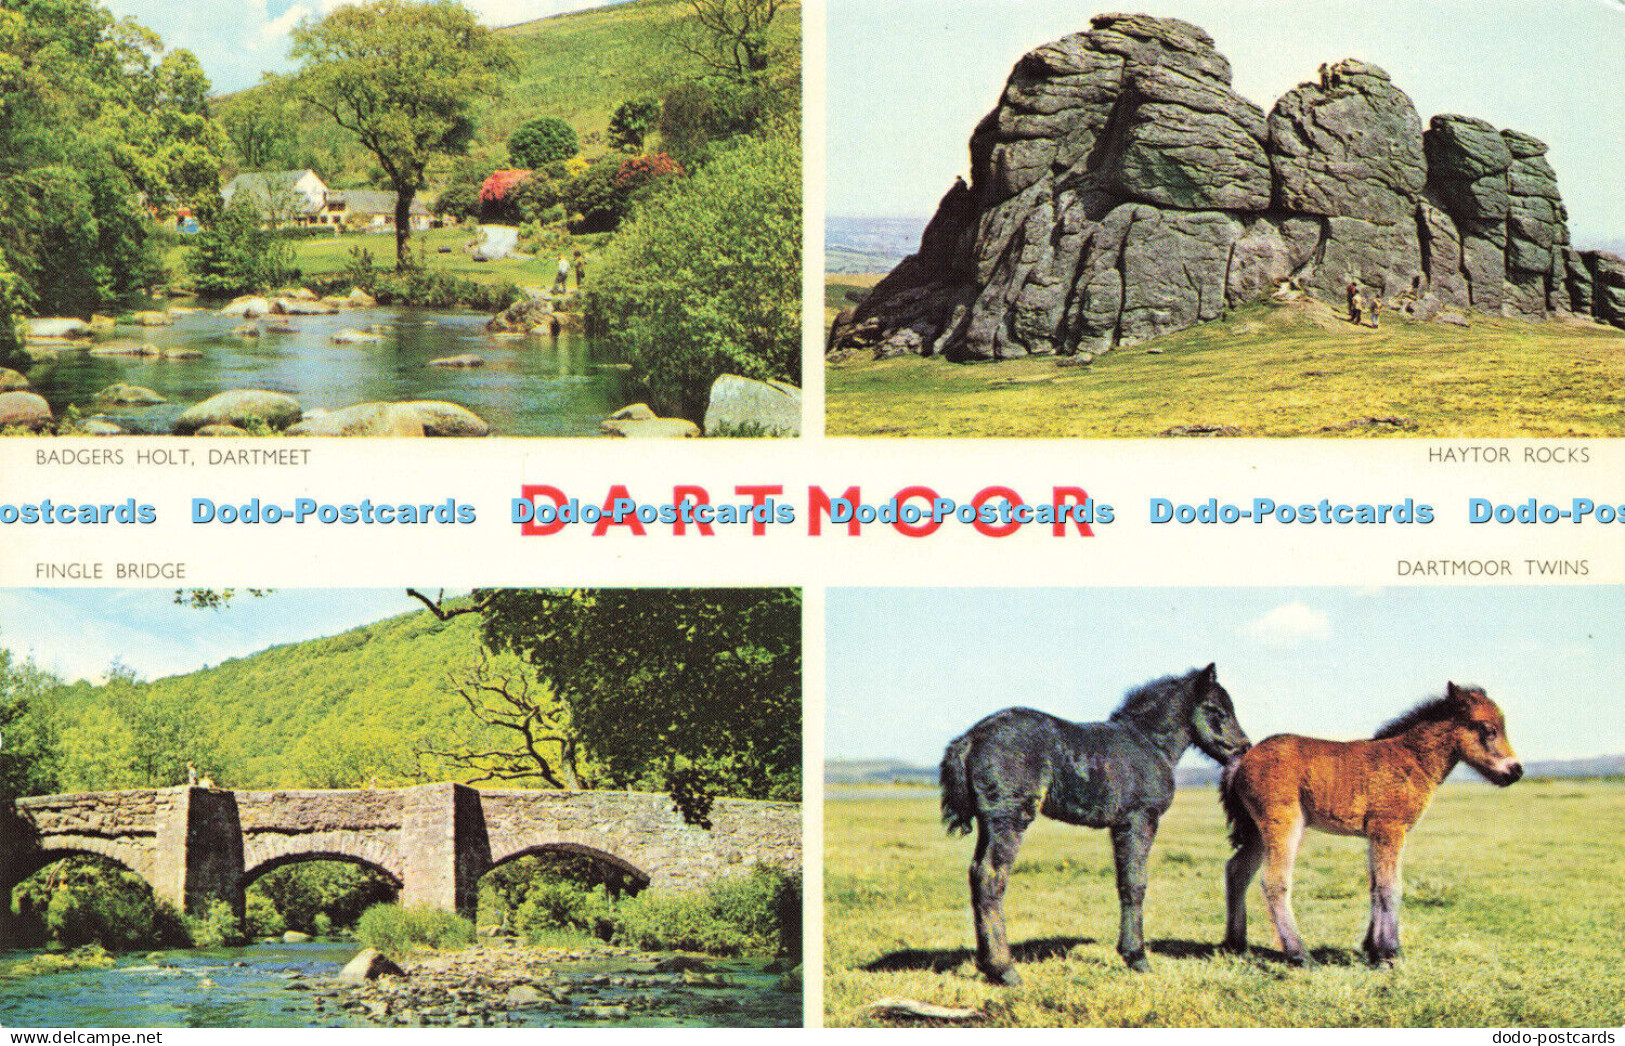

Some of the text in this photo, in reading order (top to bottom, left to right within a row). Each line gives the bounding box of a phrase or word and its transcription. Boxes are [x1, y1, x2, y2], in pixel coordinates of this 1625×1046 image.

[36, 448, 311, 467] BADGERS HOLT, DARTMEET
[1429, 446, 1590, 464] HAYTOR ROCKS
[521, 485, 1095, 537] DARTMOOR
[36, 562, 186, 579] FINGLE BRIDGE
[1397, 559, 1589, 576] DARTMOOR TWINS
